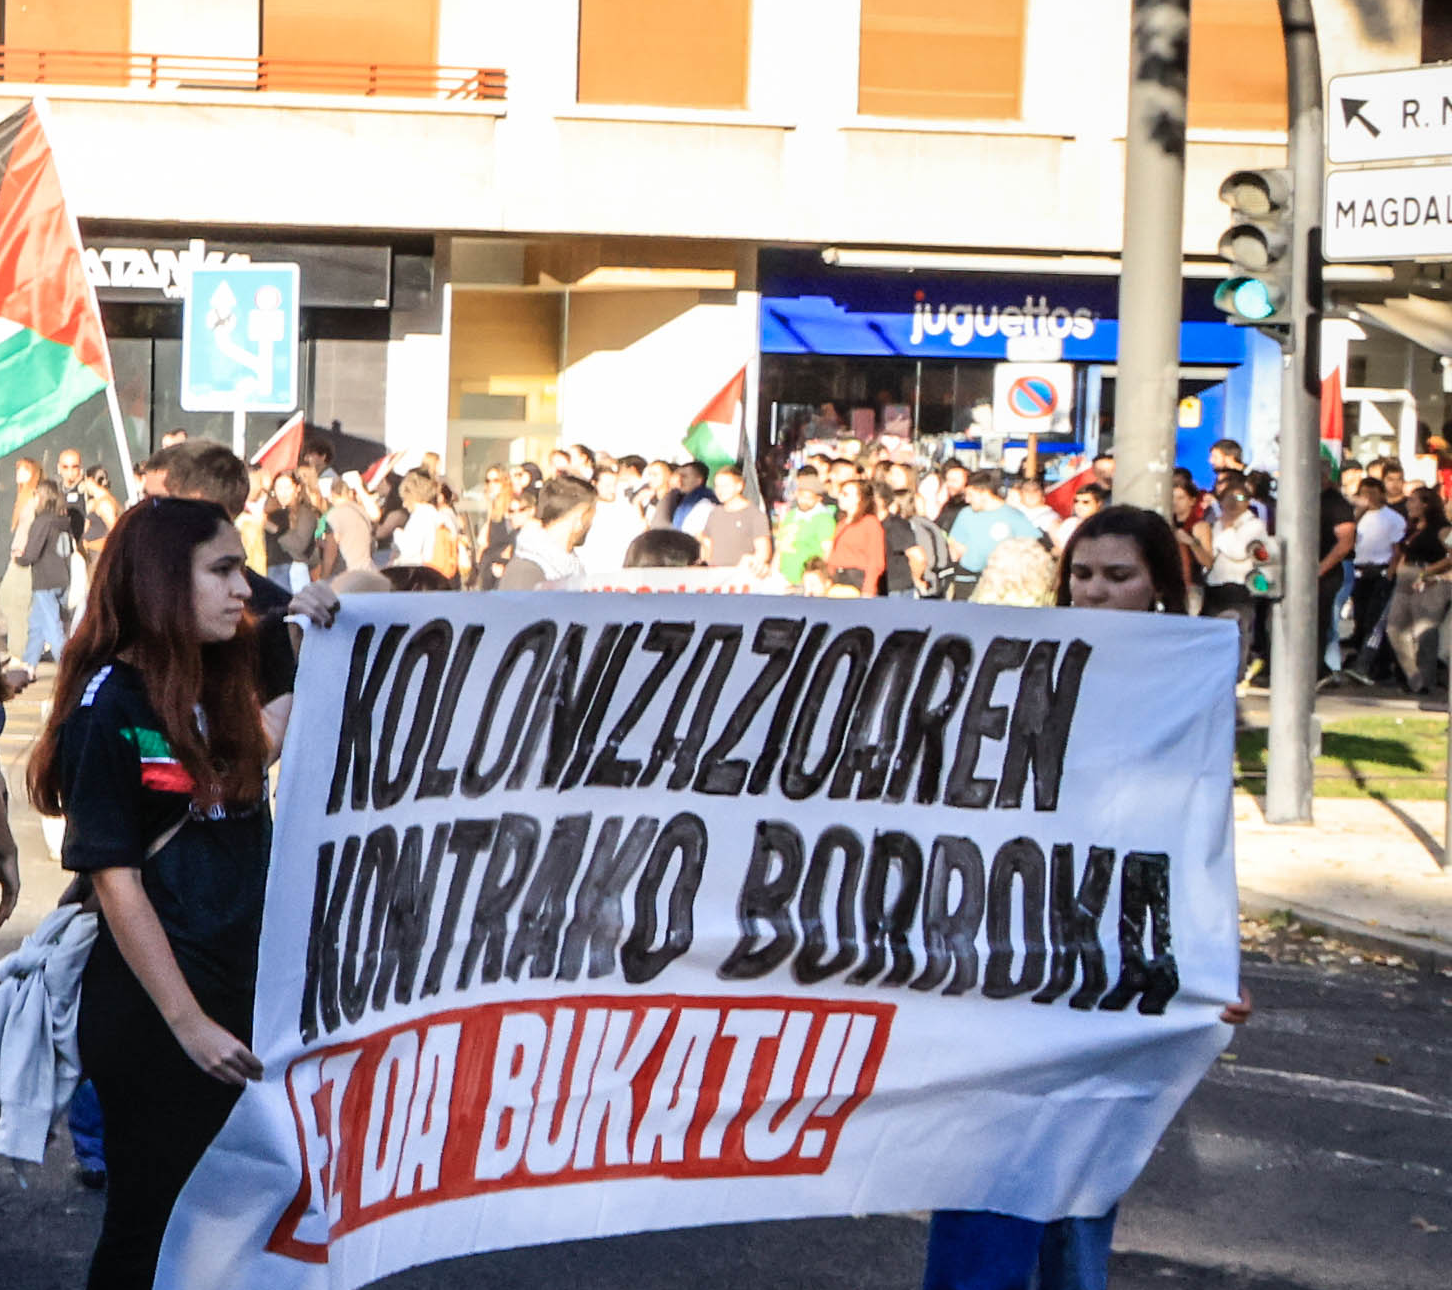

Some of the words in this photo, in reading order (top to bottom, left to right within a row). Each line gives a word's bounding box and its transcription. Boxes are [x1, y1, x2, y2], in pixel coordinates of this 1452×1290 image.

[910, 289, 1095, 347] juguettos
[326, 617, 1093, 816] KOLONIZAZIOAREN
[299, 810, 708, 1045] KONTRAKO
[717, 819, 1180, 1016] BORROKA
[292, 1049, 363, 1246] EZ
[360, 1022, 462, 1209] DA
[474, 1008, 878, 1182] BUKATU!!
